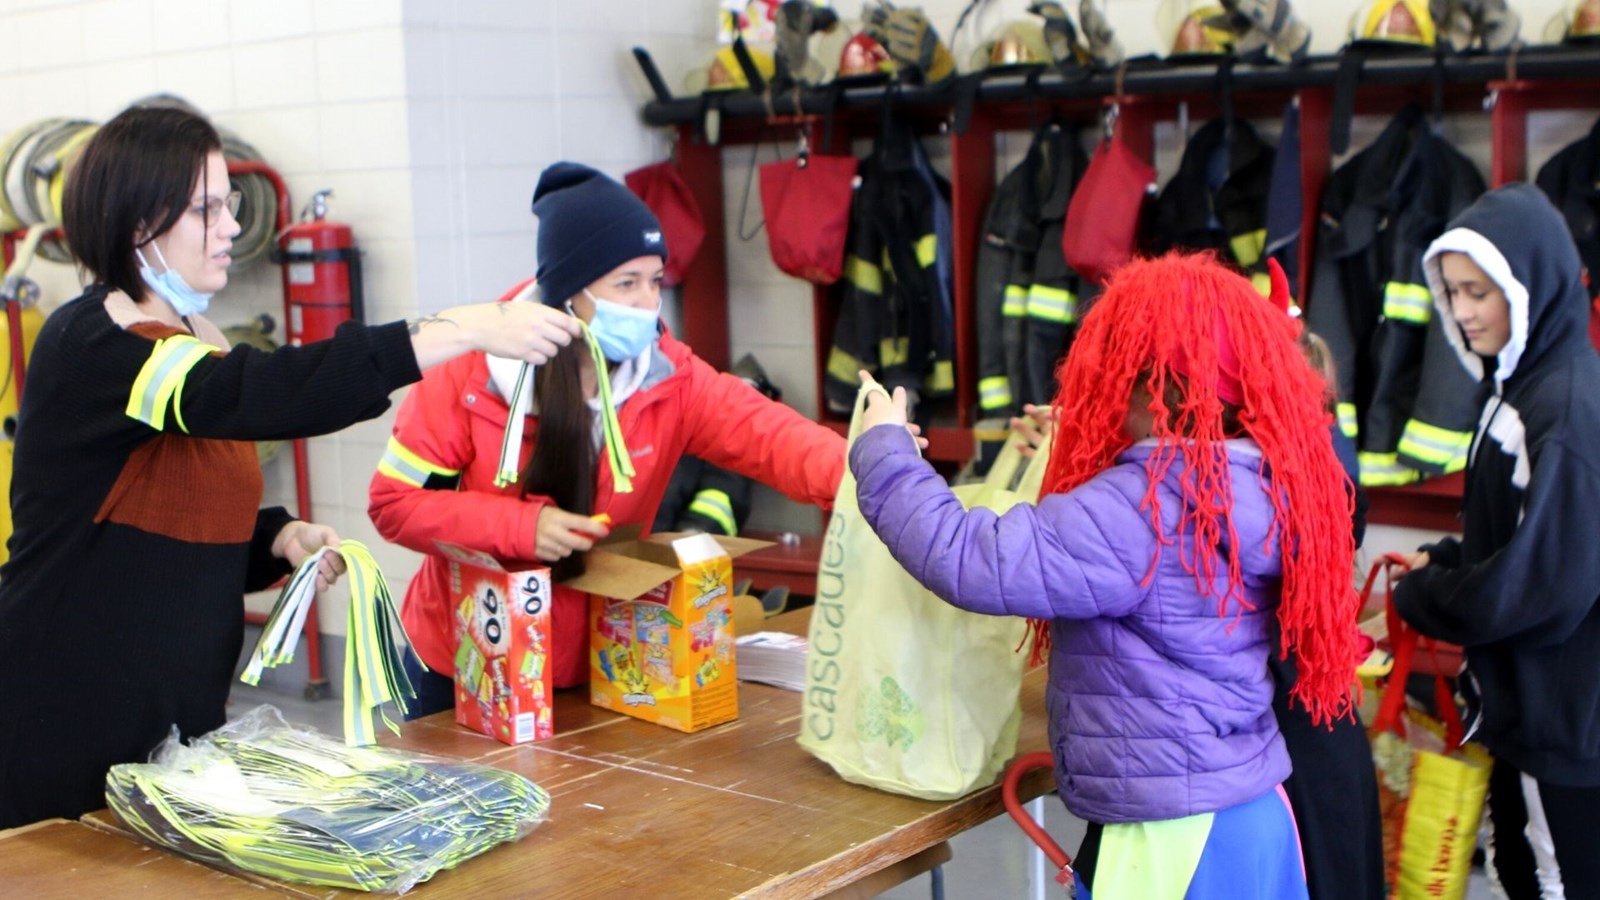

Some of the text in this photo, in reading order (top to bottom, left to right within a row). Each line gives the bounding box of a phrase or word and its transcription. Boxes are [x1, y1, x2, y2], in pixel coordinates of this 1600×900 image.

[483, 587, 502, 645] 90
[521, 575, 543, 615] 90
[807, 511, 846, 741] cascades
